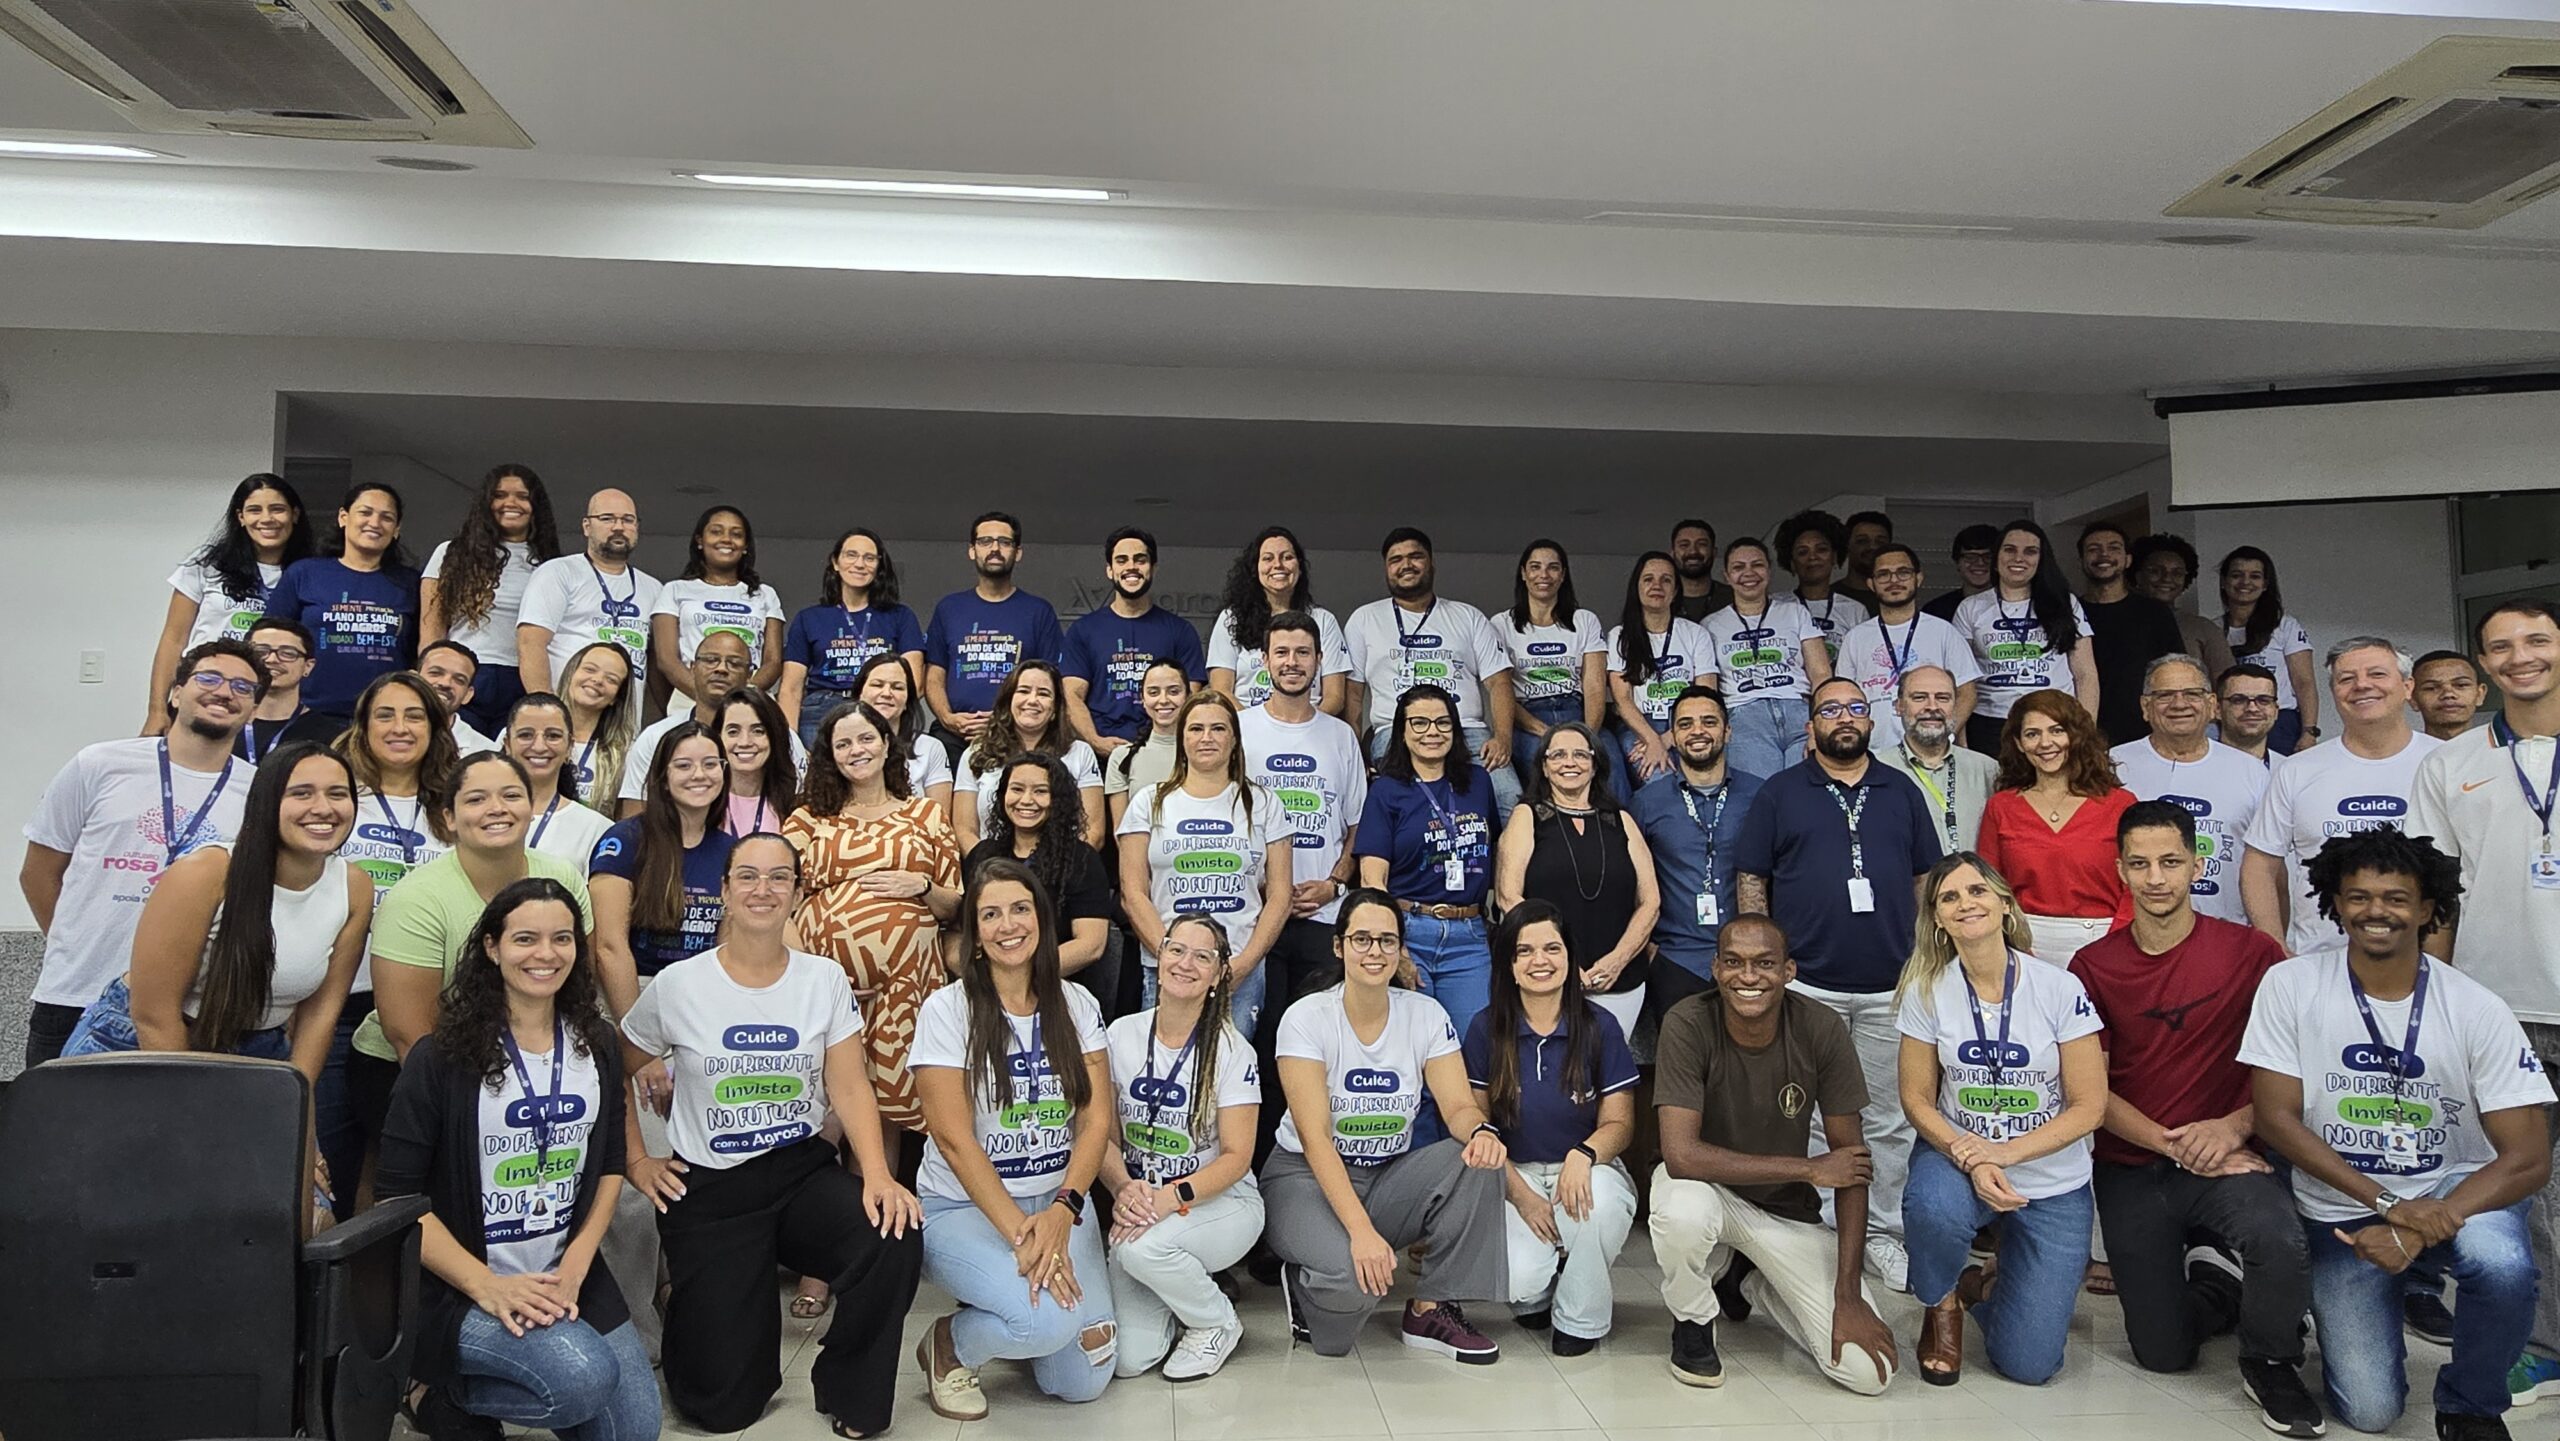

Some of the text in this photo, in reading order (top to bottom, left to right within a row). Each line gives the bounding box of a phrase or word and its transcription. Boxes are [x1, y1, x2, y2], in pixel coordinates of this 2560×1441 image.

[322, 612, 399, 626] PLANO DE SAÚDE
[336, 622, 387, 634] DO AGROS
[825, 648, 851, 659] PLANO
[957, 640, 1017, 654] PLANO DE SAÚDE
[967, 652, 978, 662] DO
[1862, 677, 1888, 688] rosa
[1273, 758, 1310, 769] Cuide
[1283, 797, 1313, 807] vista
[2347, 800, 2398, 812] Cuide
[1185, 822, 1225, 831] Cuide
[1291, 812, 1327, 832] TURO
[1460, 821, 1486, 835] SAÚDE
[2323, 820, 2344, 837] DO
[1163, 837, 1249, 854] DO PRESENTE
[1293, 832, 1319, 845] ros!
[103, 856, 158, 873] rosa
[1181, 858, 1234, 869] Invista
[1169, 875, 1246, 895] NO FUTURO
[112, 893, 141, 903] apoia
[1199, 898, 1238, 912] Agros!
[689, 907, 703, 920] DE
[2075, 993, 2095, 1017] 4
[734, 1031, 788, 1044] Cuide
[705, 1054, 814, 1076] DO PRESENTE
[2519, 1047, 2541, 1072] 4
[1244, 1063, 1261, 1085] 4
[1352, 1075, 1391, 1087] Cuide
[2326, 1073, 2350, 1092] DO
[726, 1083, 791, 1098] Invista
[1331, 1094, 1414, 1114] DO PRESENTE
[1966, 1093, 2029, 1107] Invsta
[707, 1100, 812, 1131] NO FUTURO
[1344, 1122, 1399, 1132] Invista
[714, 1140, 739, 1148] com
[752, 1123, 804, 1148] Agros!
[2323, 1124, 2357, 1146] NO
[485, 1135, 511, 1156] DO
[986, 1133, 1015, 1156] NO
[1023, 1151, 1068, 1174] Agros!
[482, 1192, 512, 1216] NO
[485, 1227, 522, 1239] com o
